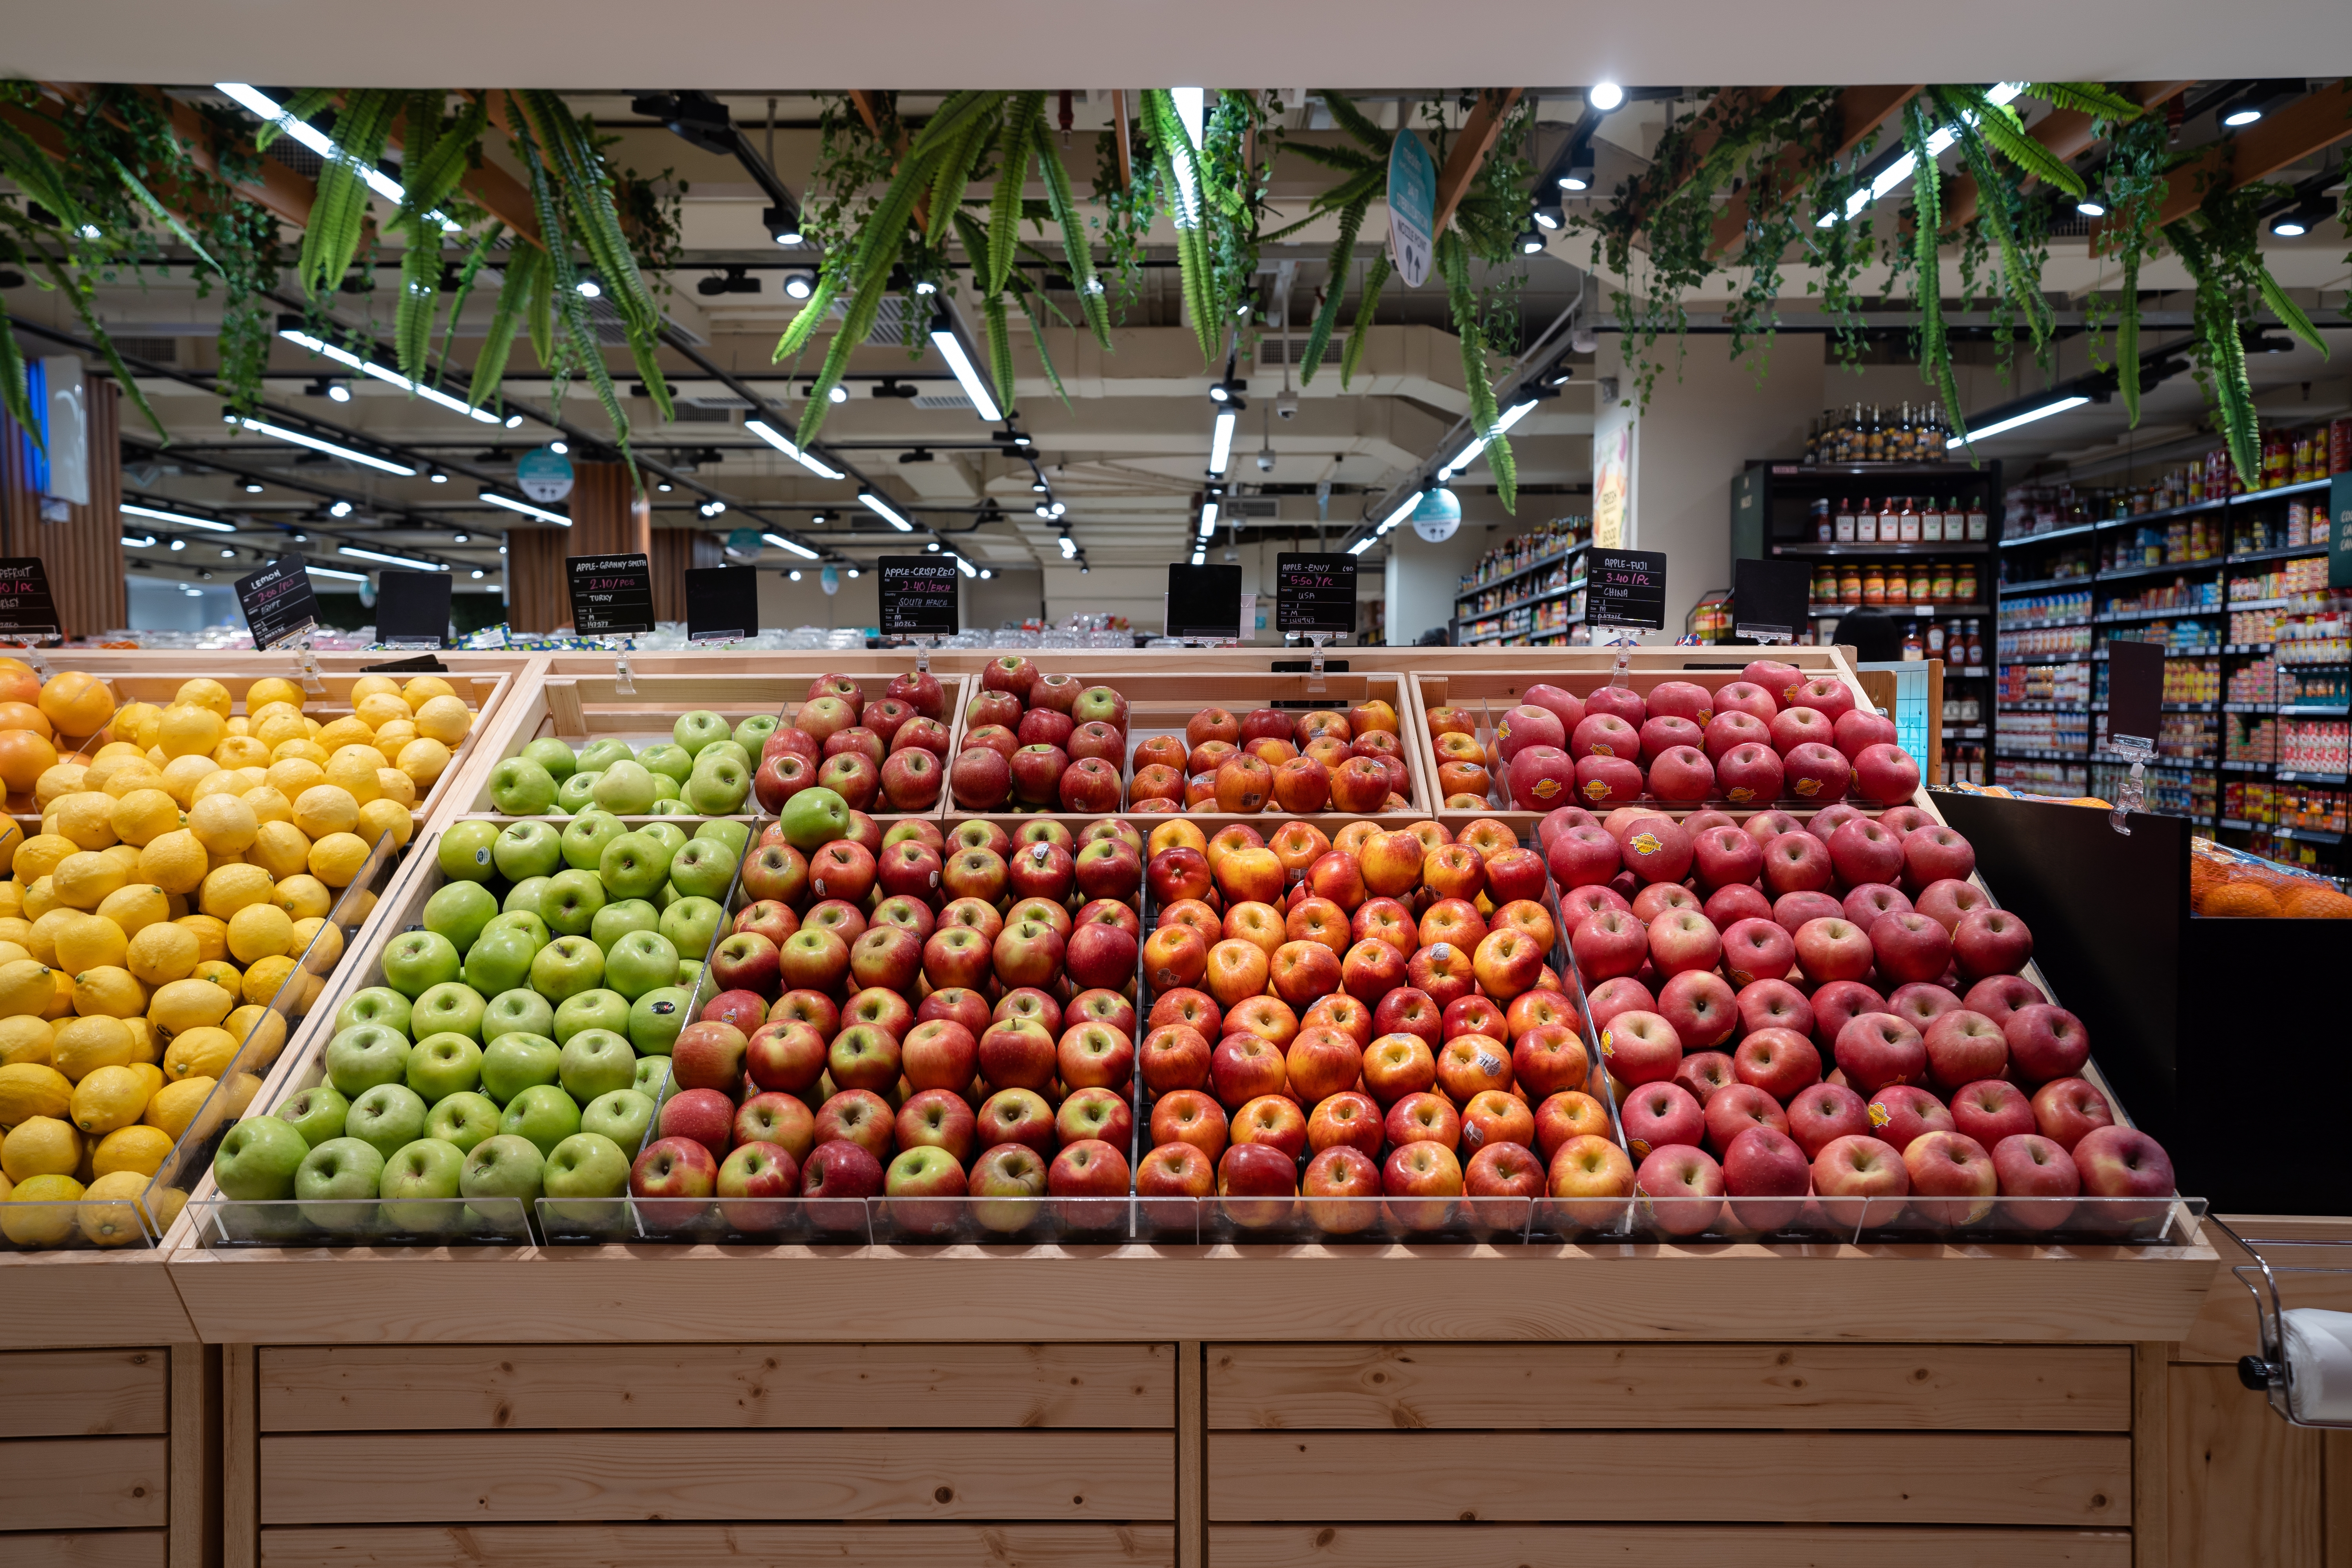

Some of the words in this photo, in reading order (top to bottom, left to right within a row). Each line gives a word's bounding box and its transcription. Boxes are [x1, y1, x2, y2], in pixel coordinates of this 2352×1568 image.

[628, 559, 647, 567] SMITH
[936, 567, 955, 576] RED
[250, 569, 282, 590] LEMON
[1604, 587, 1628, 597] CHINA
[589, 594, 613, 603] TURKY
[898, 597, 923, 608] SOUTH
[261, 599, 281, 615] EGYPT
